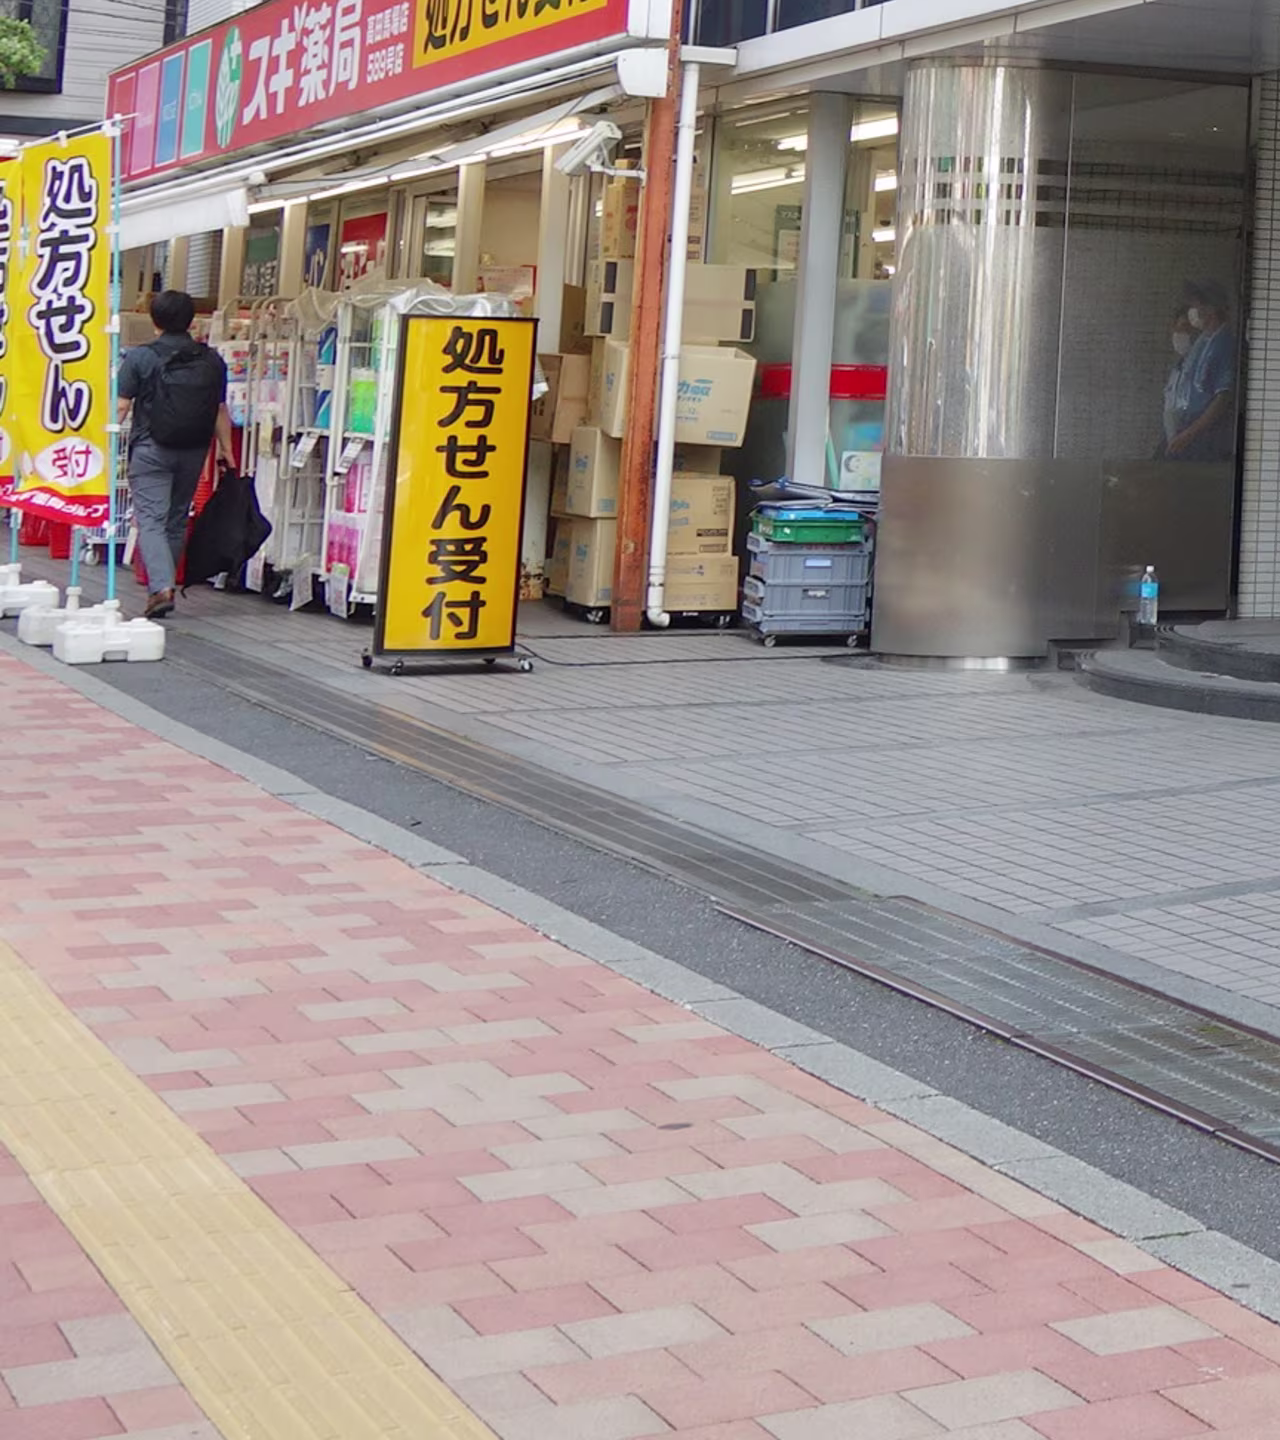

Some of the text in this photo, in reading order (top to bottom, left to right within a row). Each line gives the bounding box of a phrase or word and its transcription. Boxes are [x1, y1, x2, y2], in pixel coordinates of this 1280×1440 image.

[32, 159, 96, 431] 処方せん
[52, 444, 92, 479] 受付
[421, 325, 505, 641] 処方せん受付
